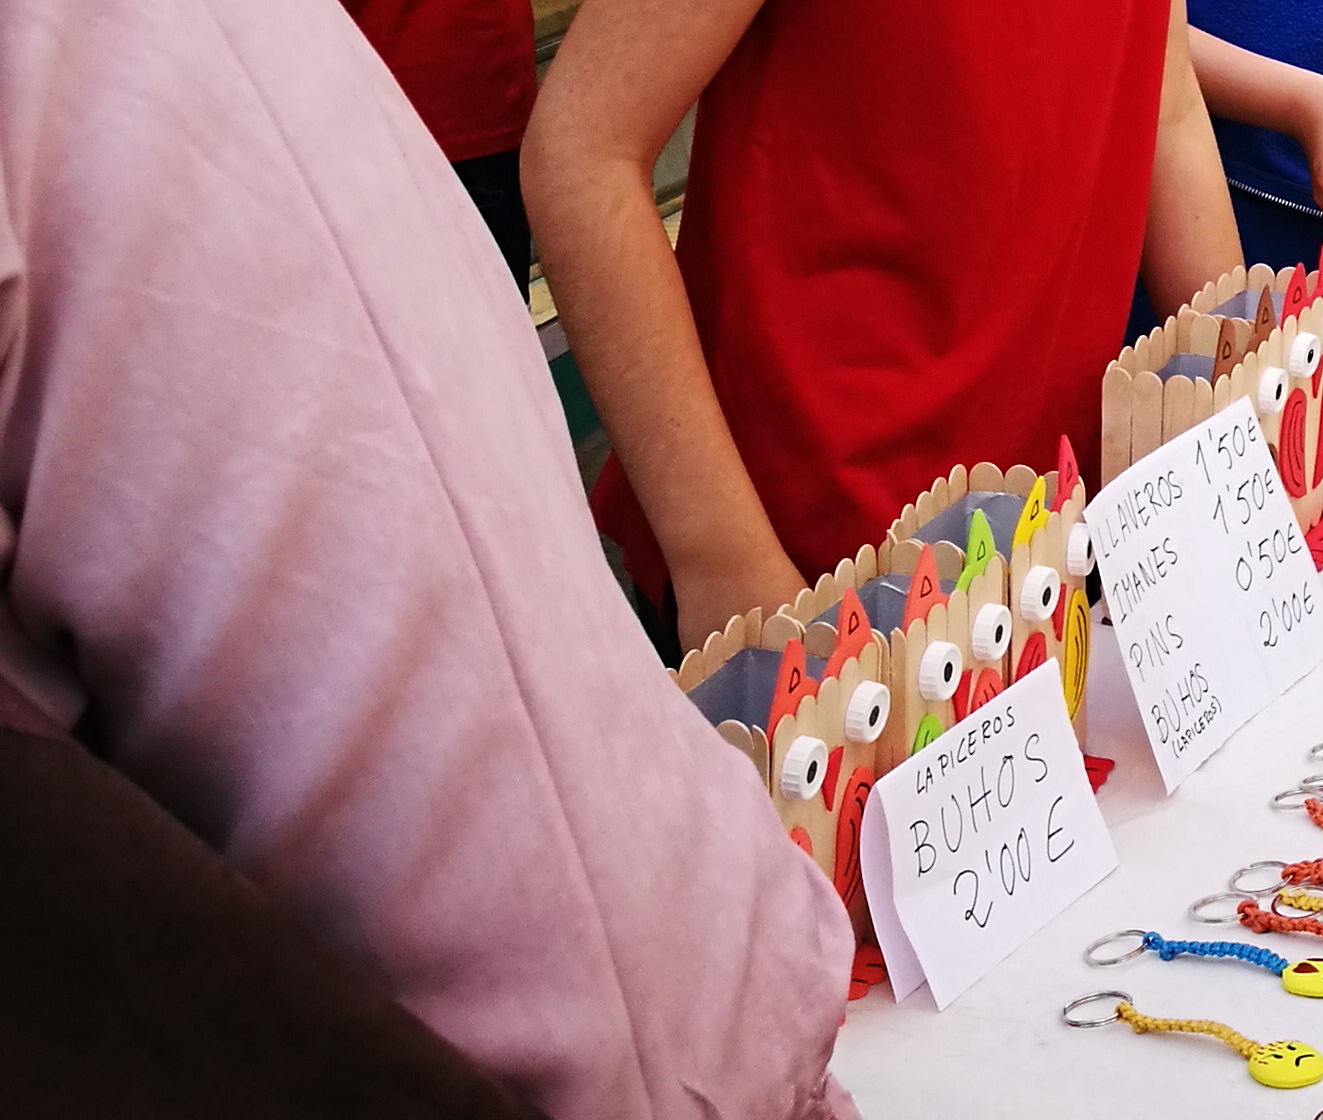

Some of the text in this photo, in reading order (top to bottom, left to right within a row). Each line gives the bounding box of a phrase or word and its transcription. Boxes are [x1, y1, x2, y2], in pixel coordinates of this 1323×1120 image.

[1098, 469, 1184, 559] LLAVEROS
[1111, 536, 1179, 623] IMANES
[1128, 614, 1184, 683] PINS
[1150, 662, 1210, 746] BUHOS
[1172, 695, 1223, 760] (LAPICEROS)
[915, 705, 1016, 795] LAPICEROS
[909, 732, 1049, 878] BUHOS
